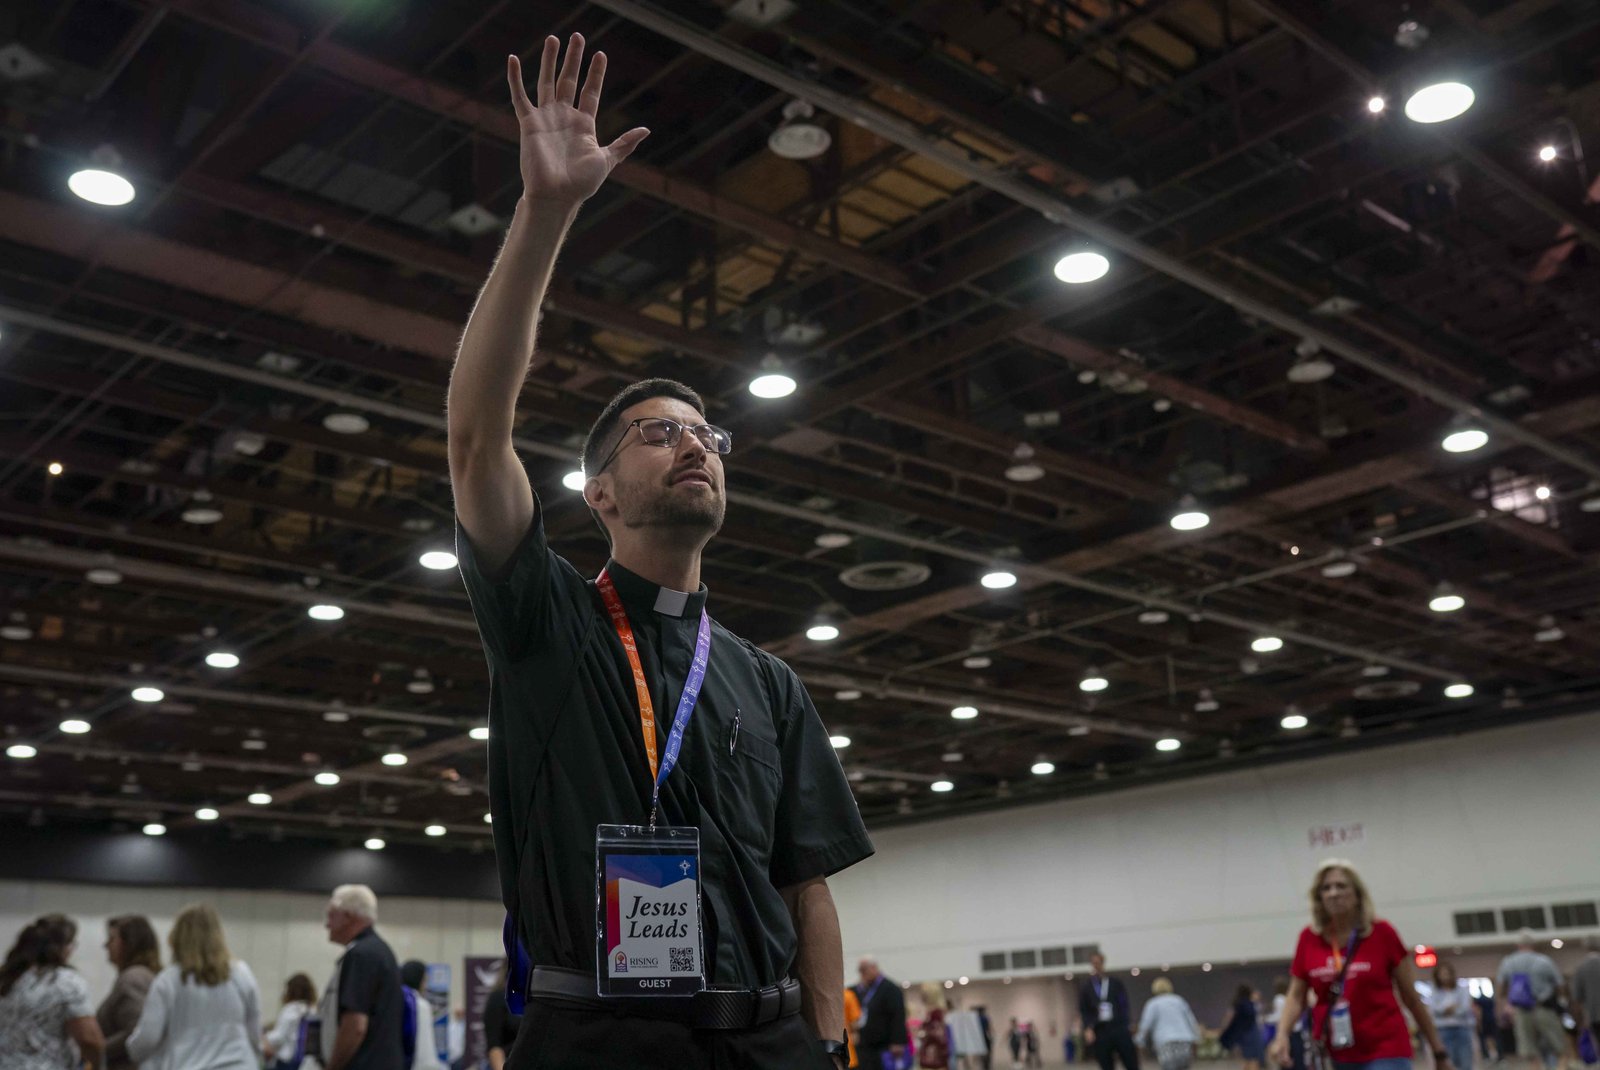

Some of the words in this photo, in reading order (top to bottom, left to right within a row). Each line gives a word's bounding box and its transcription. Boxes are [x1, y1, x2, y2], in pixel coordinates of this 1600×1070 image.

[626, 896, 688, 919] Jesus
[628, 919, 688, 938] Leads
[629, 957, 659, 965] RISING
[639, 979, 672, 988] GUEST
